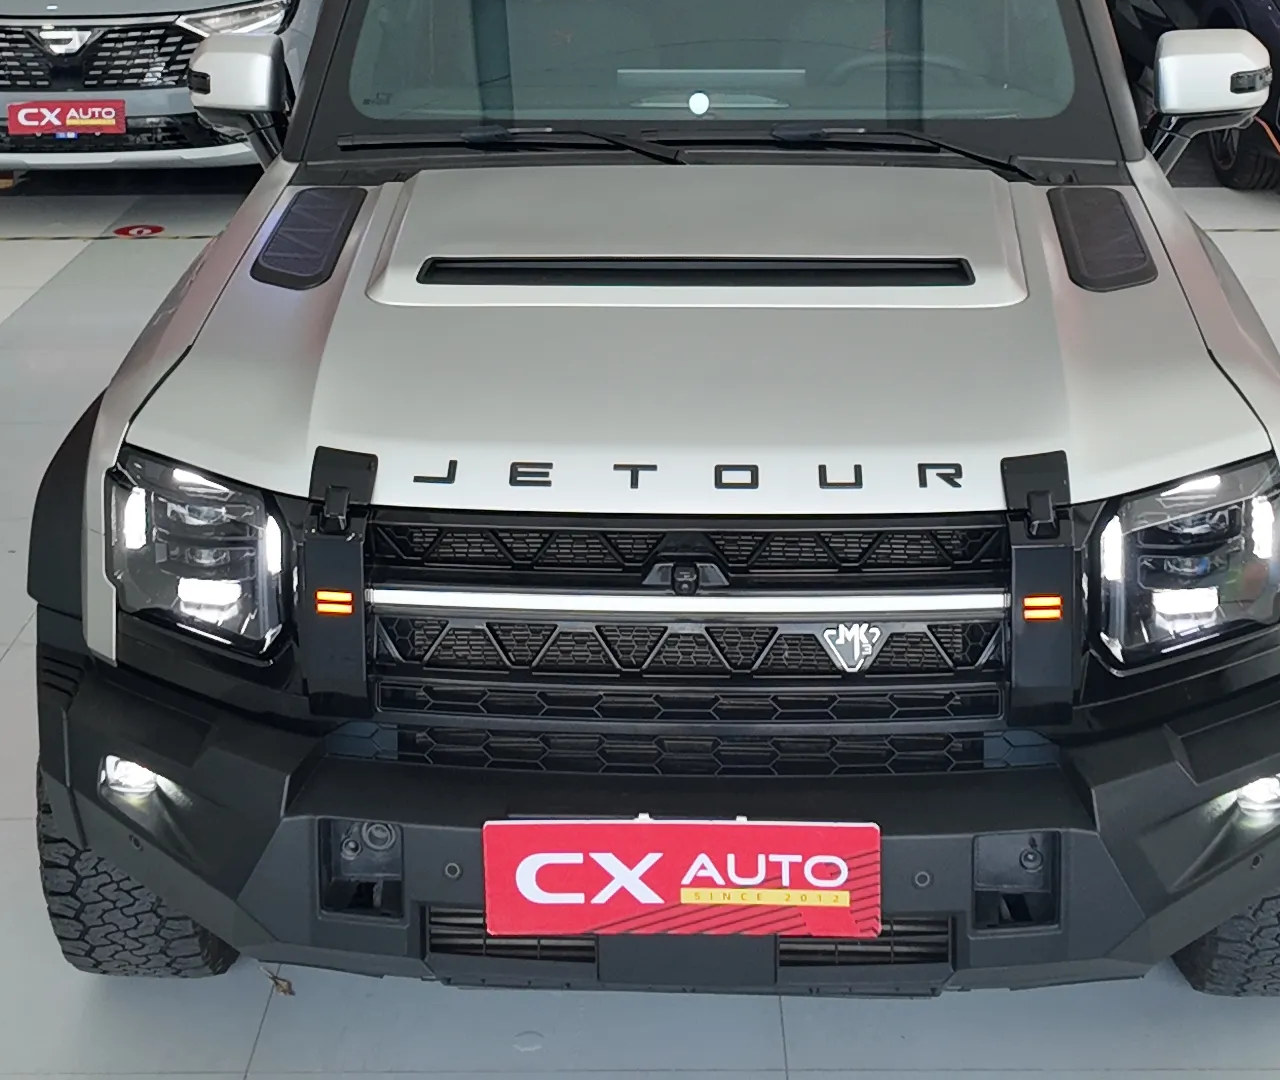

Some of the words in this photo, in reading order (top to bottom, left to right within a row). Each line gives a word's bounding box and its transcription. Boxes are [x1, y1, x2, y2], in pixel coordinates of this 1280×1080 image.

[17, 107, 62, 126] CX
[66, 107, 116, 119] AUTO
[413, 460, 963, 490] JETOUR
[515, 852, 665, 904] CX
[680, 853, 849, 887] AUTO
[694, 891, 764, 902] SINCE
[785, 892, 841, 903] 2012
